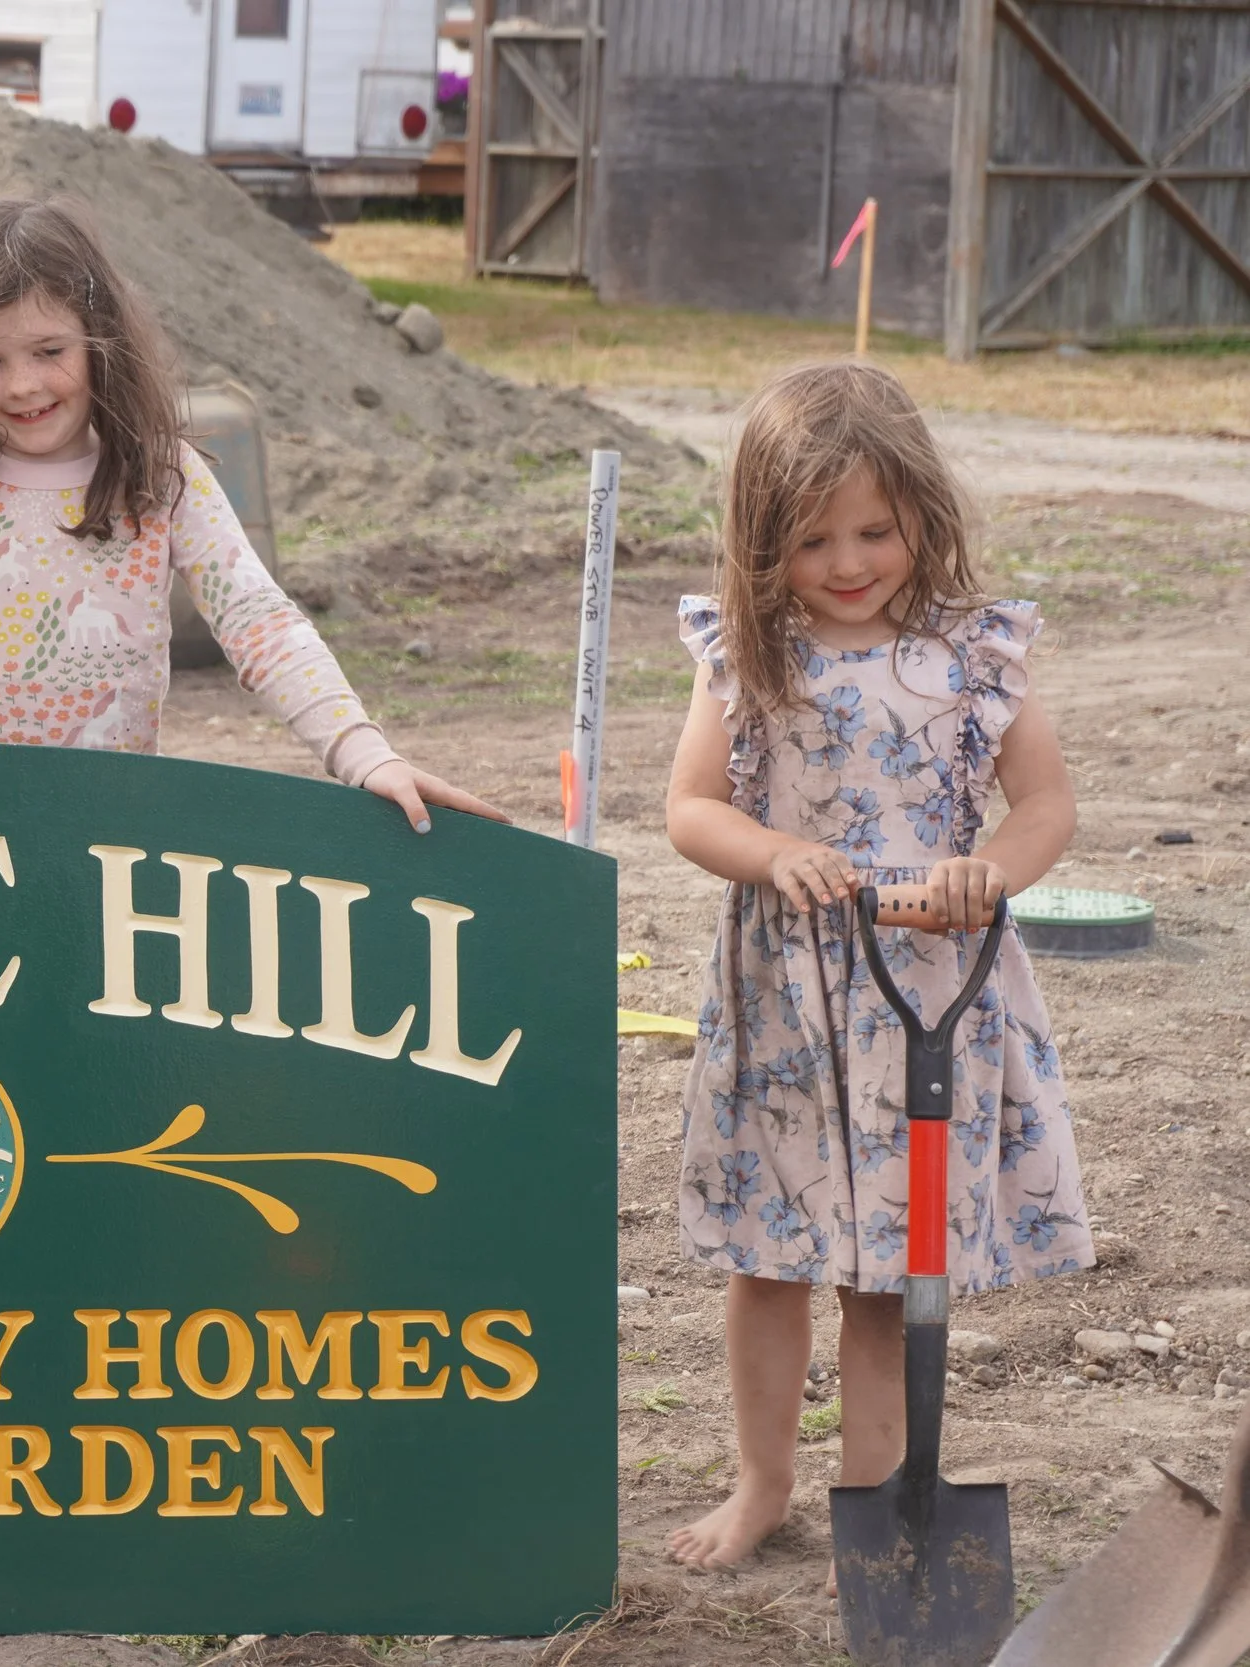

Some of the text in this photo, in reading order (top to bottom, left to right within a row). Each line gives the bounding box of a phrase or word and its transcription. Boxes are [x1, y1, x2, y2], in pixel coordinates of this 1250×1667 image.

[588, 487, 609, 558] POWER
[574, 714, 593, 735] 4
[86, 843, 525, 1090] HILL
[72, 1307, 540, 1403] HOMES
